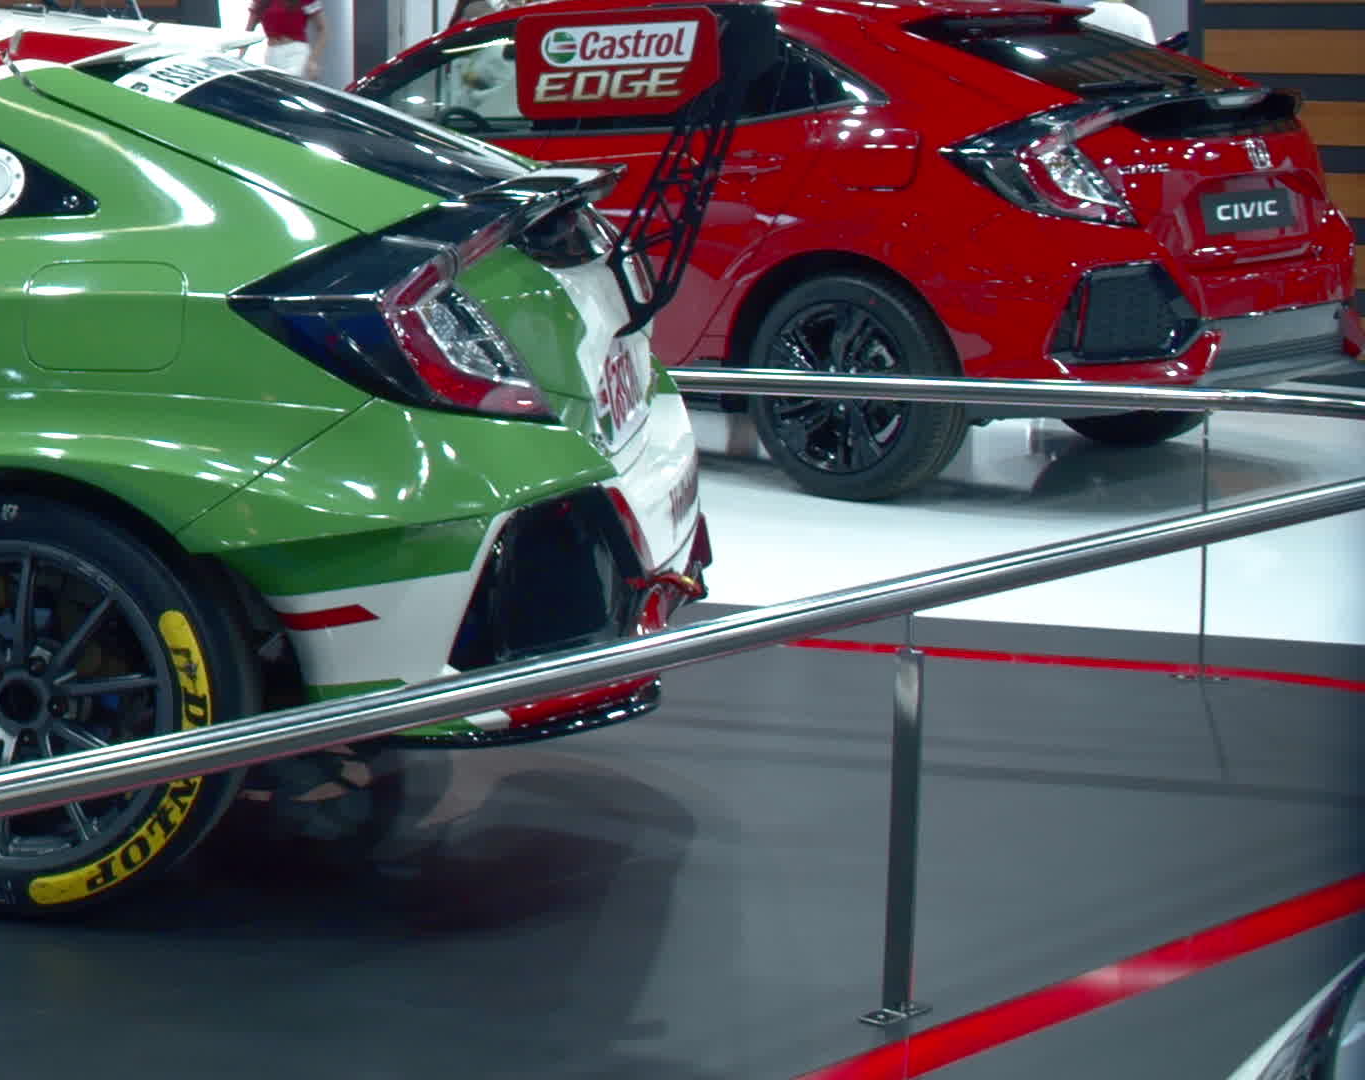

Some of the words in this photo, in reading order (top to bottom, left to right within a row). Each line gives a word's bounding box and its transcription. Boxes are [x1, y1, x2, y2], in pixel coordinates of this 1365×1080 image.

[579, 27, 686, 61] Castrol
[533, 66, 686, 104] EDGE
[1216, 199, 1279, 221] CIVIC
[86, 692, 208, 892] DNLOP
